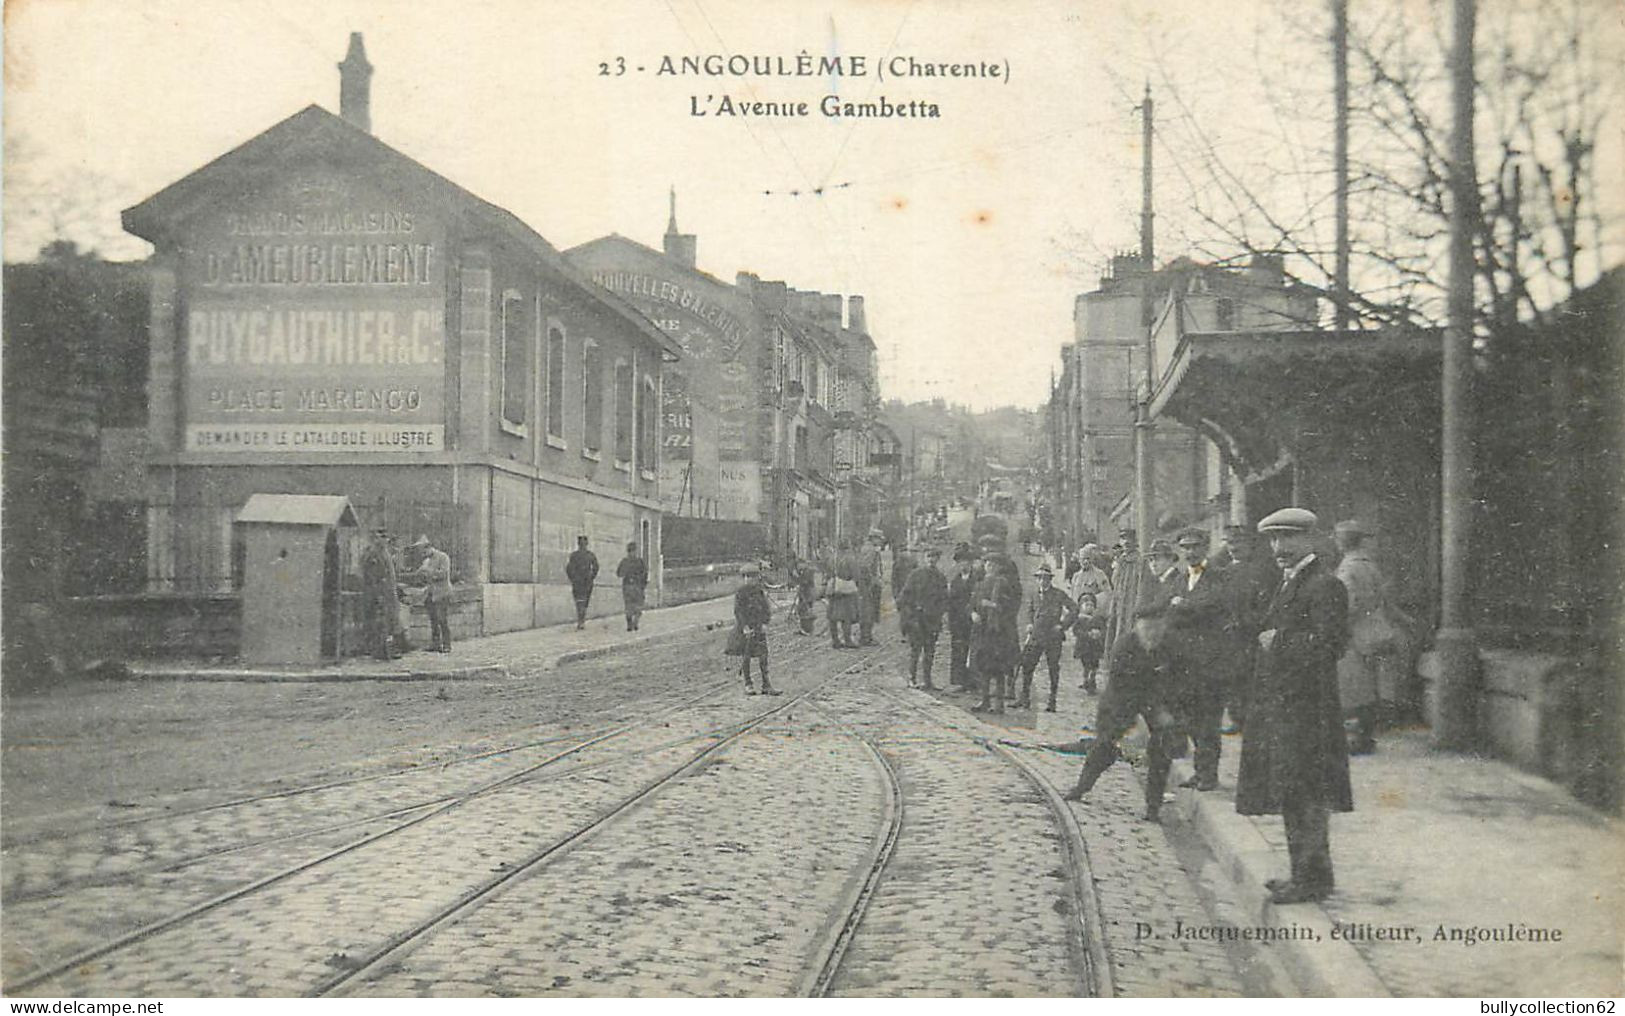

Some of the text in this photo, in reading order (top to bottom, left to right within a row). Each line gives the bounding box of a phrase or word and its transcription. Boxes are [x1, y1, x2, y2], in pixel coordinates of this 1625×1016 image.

[206, 386, 422, 413] PLACE MARENGO
[196, 430, 270, 446] DEMANDER
[276, 431, 288, 446] LE
[293, 430, 368, 446] CATALOGUE
